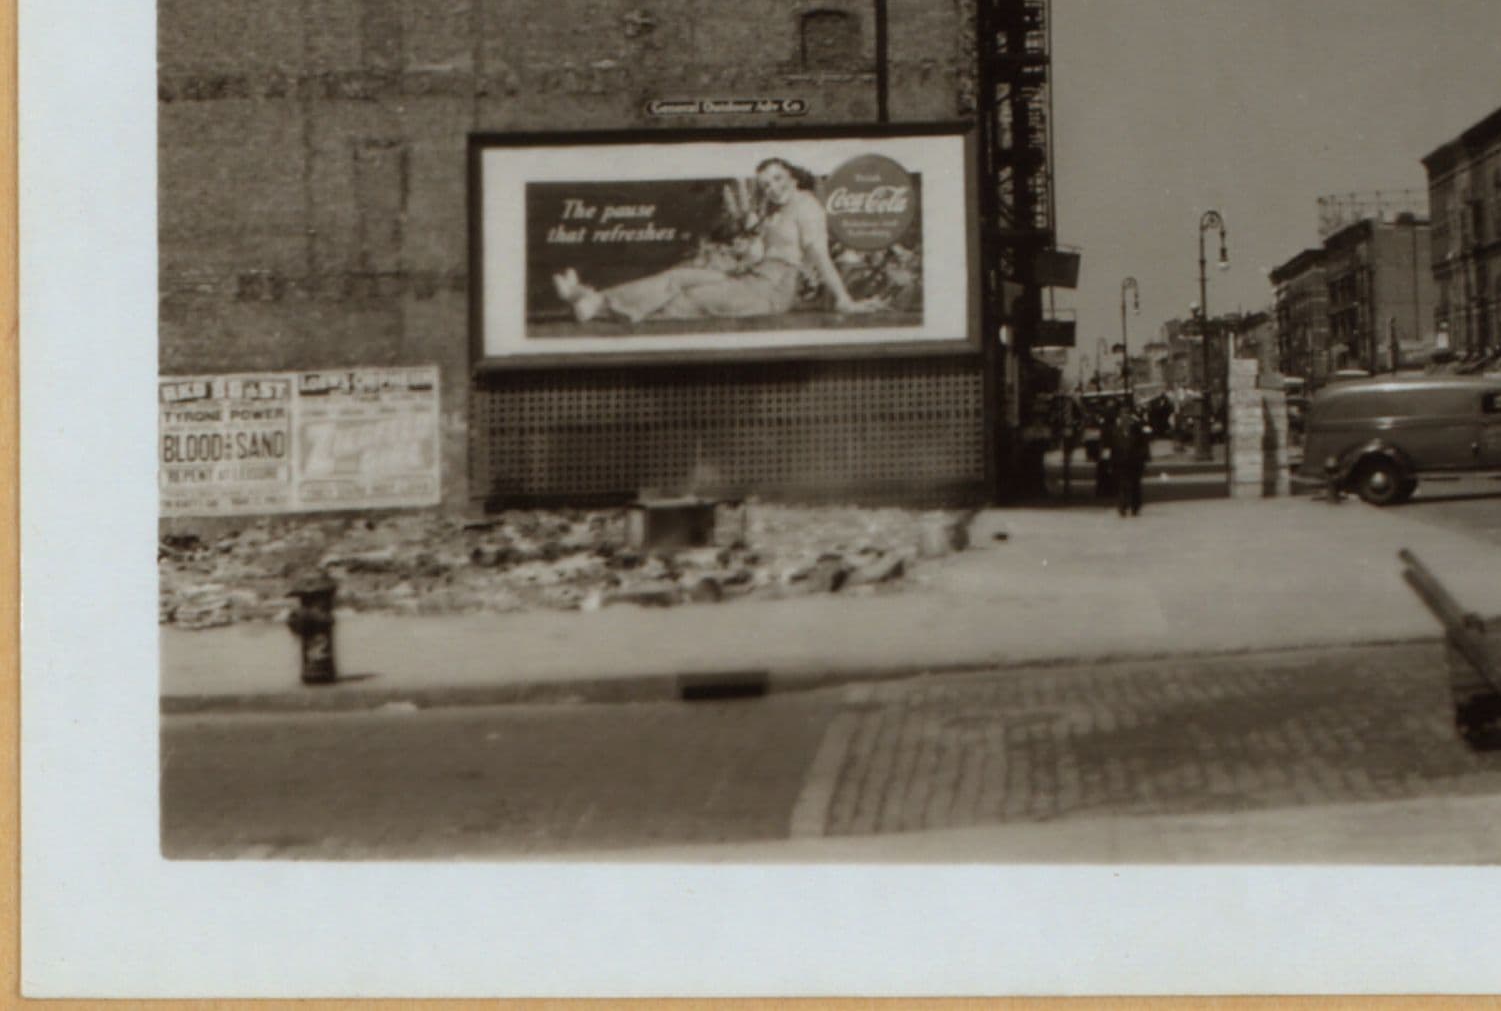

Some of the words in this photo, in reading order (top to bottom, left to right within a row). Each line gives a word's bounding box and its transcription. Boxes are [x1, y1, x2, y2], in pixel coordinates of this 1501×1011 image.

[562, 198, 598, 219] The
[600, 204, 657, 224] pause
[826, 185, 909, 215] Coca-Cola
[546, 223, 588, 243] that
[163, 410, 222, 422] TYRONE
[229, 407, 285, 421] POWER
[163, 433, 222, 462] BLOOD
[236, 430, 285, 459] SAND
